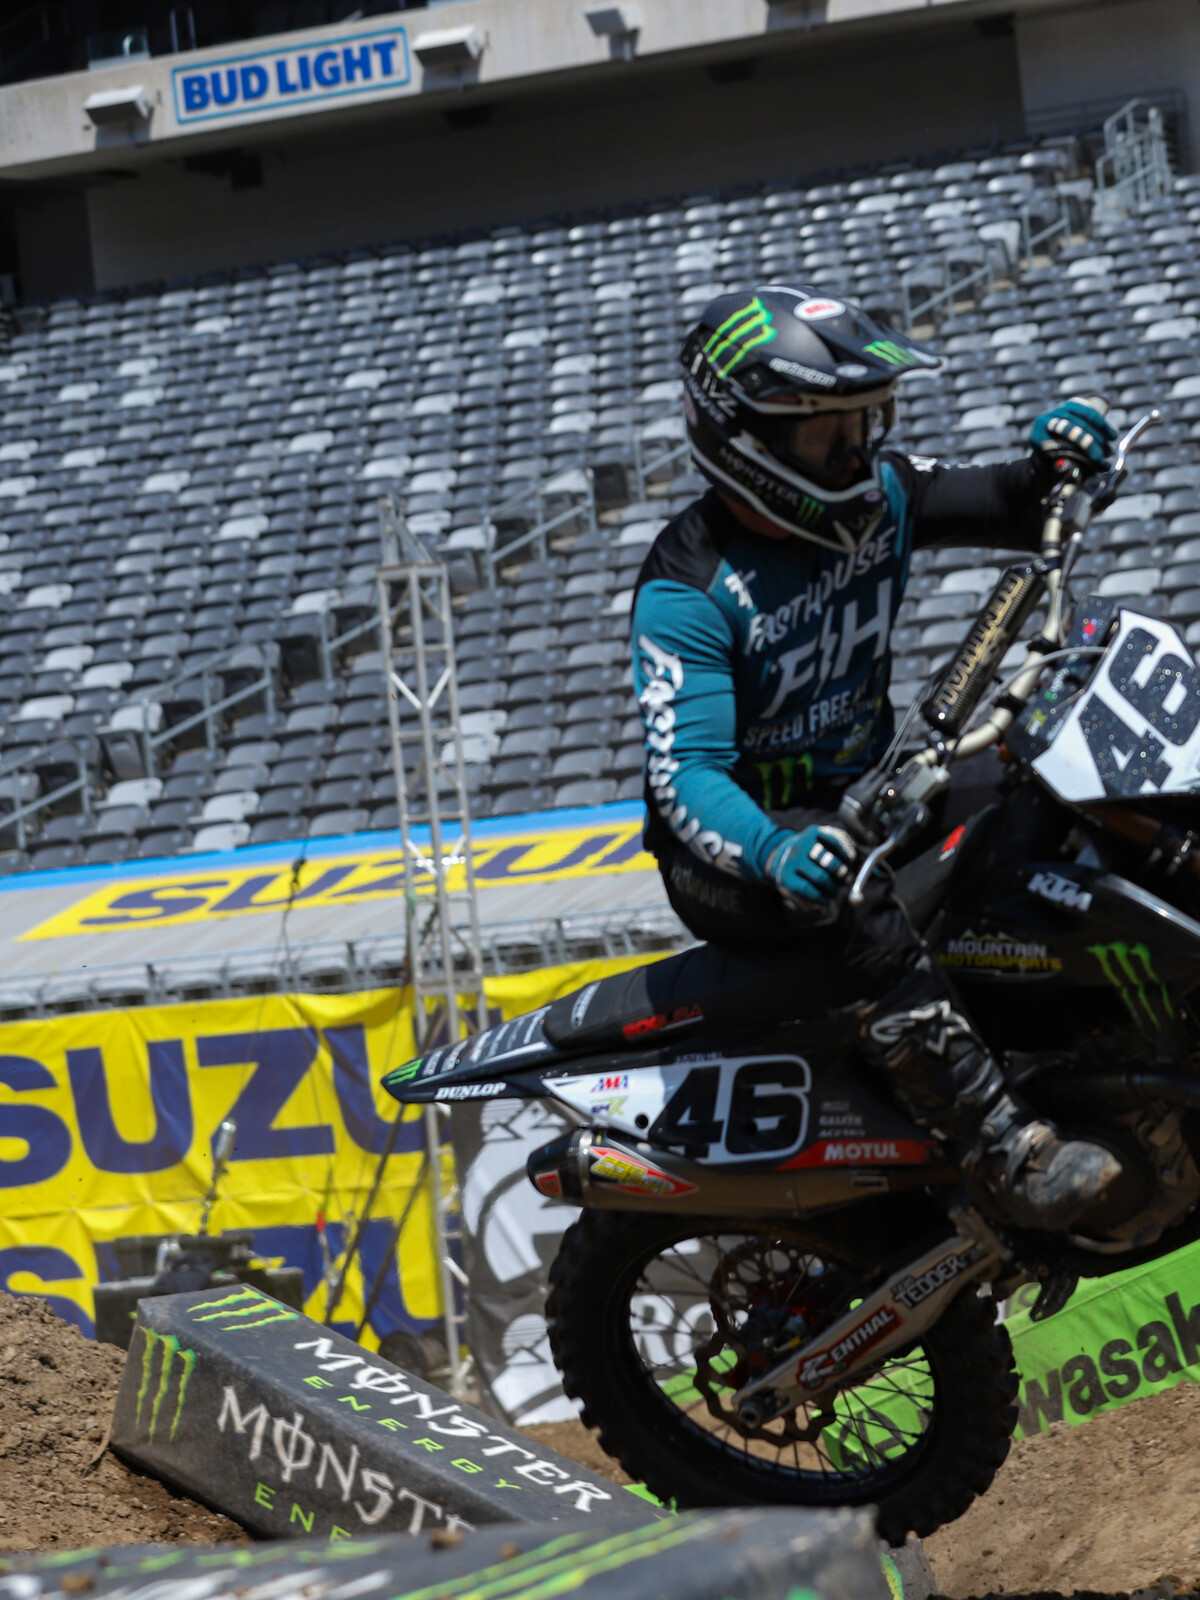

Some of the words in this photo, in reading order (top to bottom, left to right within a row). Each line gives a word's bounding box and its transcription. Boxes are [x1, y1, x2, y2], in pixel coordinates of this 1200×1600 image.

[182, 64, 269, 112] BUD
[275, 39, 397, 95] LIGHT
[744, 526, 897, 656] FASTHOUSE
[1026, 872, 1093, 912] KTM
[938, 953, 1063, 972] MOTORSPORTS
[949, 938, 1048, 958] MOUNTAIN
[434, 1082, 507, 1101] DUNLOP
[591, 1075, 630, 1094] AMA
[648, 1060, 809, 1160] 46
[824, 1143, 900, 1162] MOTUL
[894, 1253, 969, 1309] TEDDER
[303, 1374, 523, 1491] ENERGY
